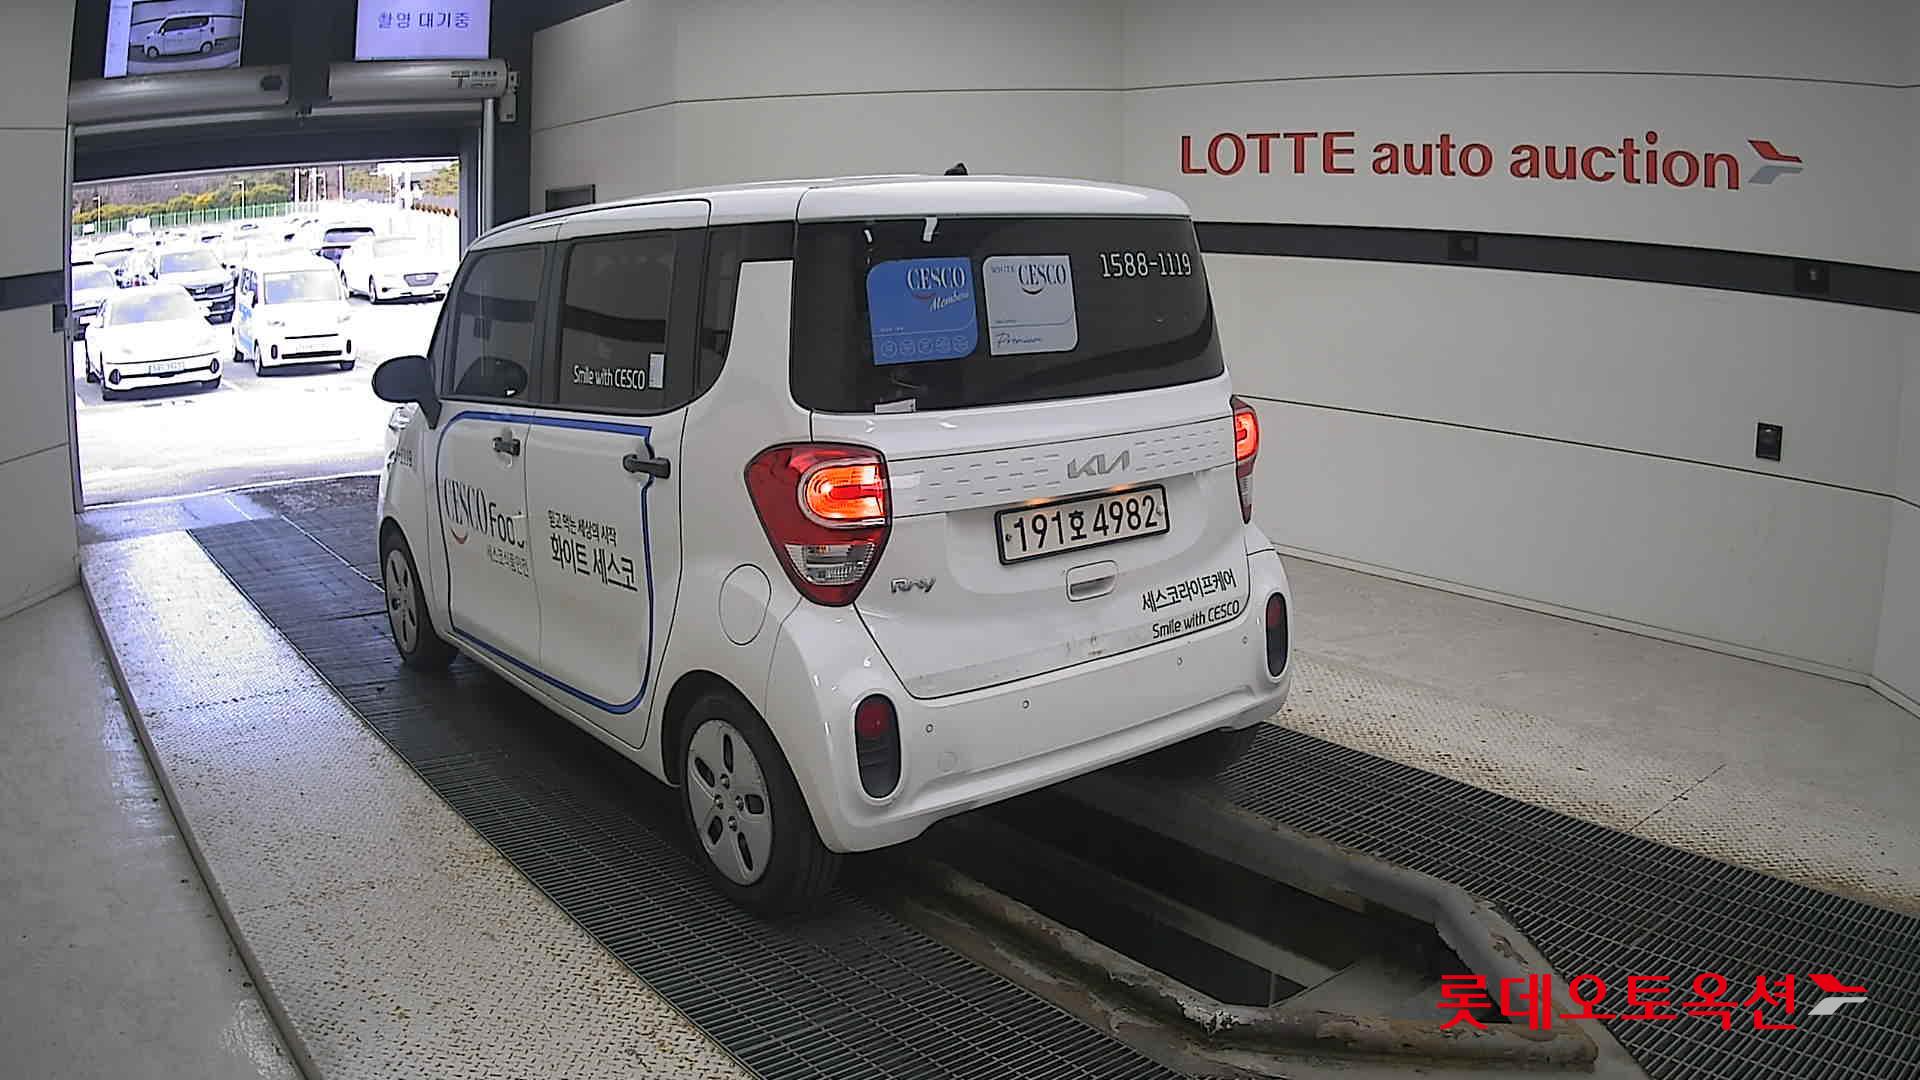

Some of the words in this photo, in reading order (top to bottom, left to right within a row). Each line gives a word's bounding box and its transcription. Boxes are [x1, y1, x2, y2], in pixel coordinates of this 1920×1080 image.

[418, 11, 471, 29] 대기중
[1181, 131, 1355, 176] LOTTE
[1371, 133, 1494, 177] auto
[1509, 130, 1740, 190] auction
[906, 265, 966, 291] CESCO
[1017, 263, 1067, 286] CESCO
[1099, 252, 1192, 277] 1588-1119
[573, 364, 594, 385] Smile
[595, 367, 613, 386] with
[614, 368, 646, 390] CESCO
[443, 478, 488, 535] CESCO
[550, 532, 590, 576] 화이트
[593, 548, 638, 593] 세스코
[1142, 567, 1237, 613] 세스코라이프케어
[1152, 618, 1181, 639] Smile
[1183, 610, 1206, 631] with
[1207, 599, 1240, 623] CESCO
